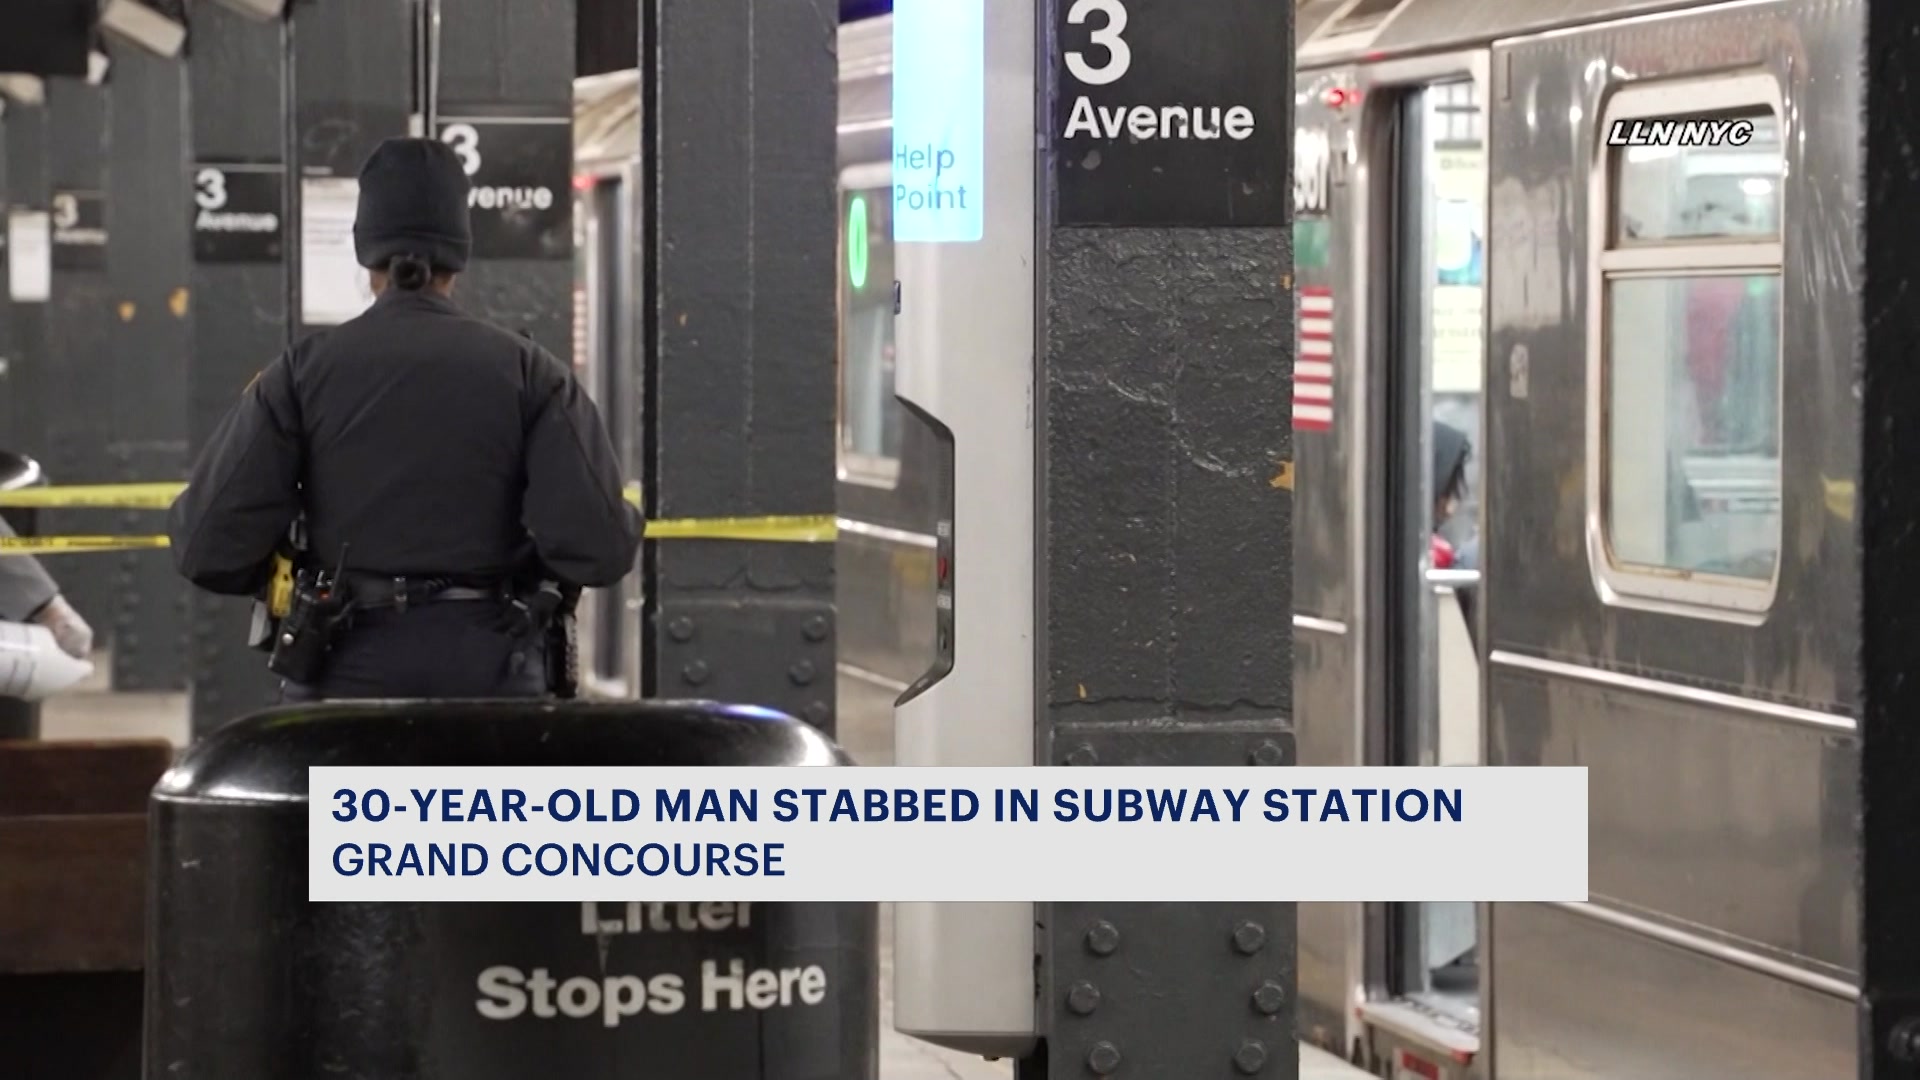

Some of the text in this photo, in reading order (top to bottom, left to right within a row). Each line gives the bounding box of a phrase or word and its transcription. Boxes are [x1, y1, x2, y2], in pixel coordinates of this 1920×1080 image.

[1064, 0, 1132, 85] 3
[1063, 95, 1255, 140] Avenue
[441, 123, 482, 176] 3
[896, 143, 955, 176] Help
[195, 168, 228, 210] 3
[467, 186, 553, 209] venue
[896, 183, 967, 211] Point
[53, 194, 79, 228] 3
[195, 209, 279, 232] Avenue
[476, 958, 827, 1028] Stops Here
